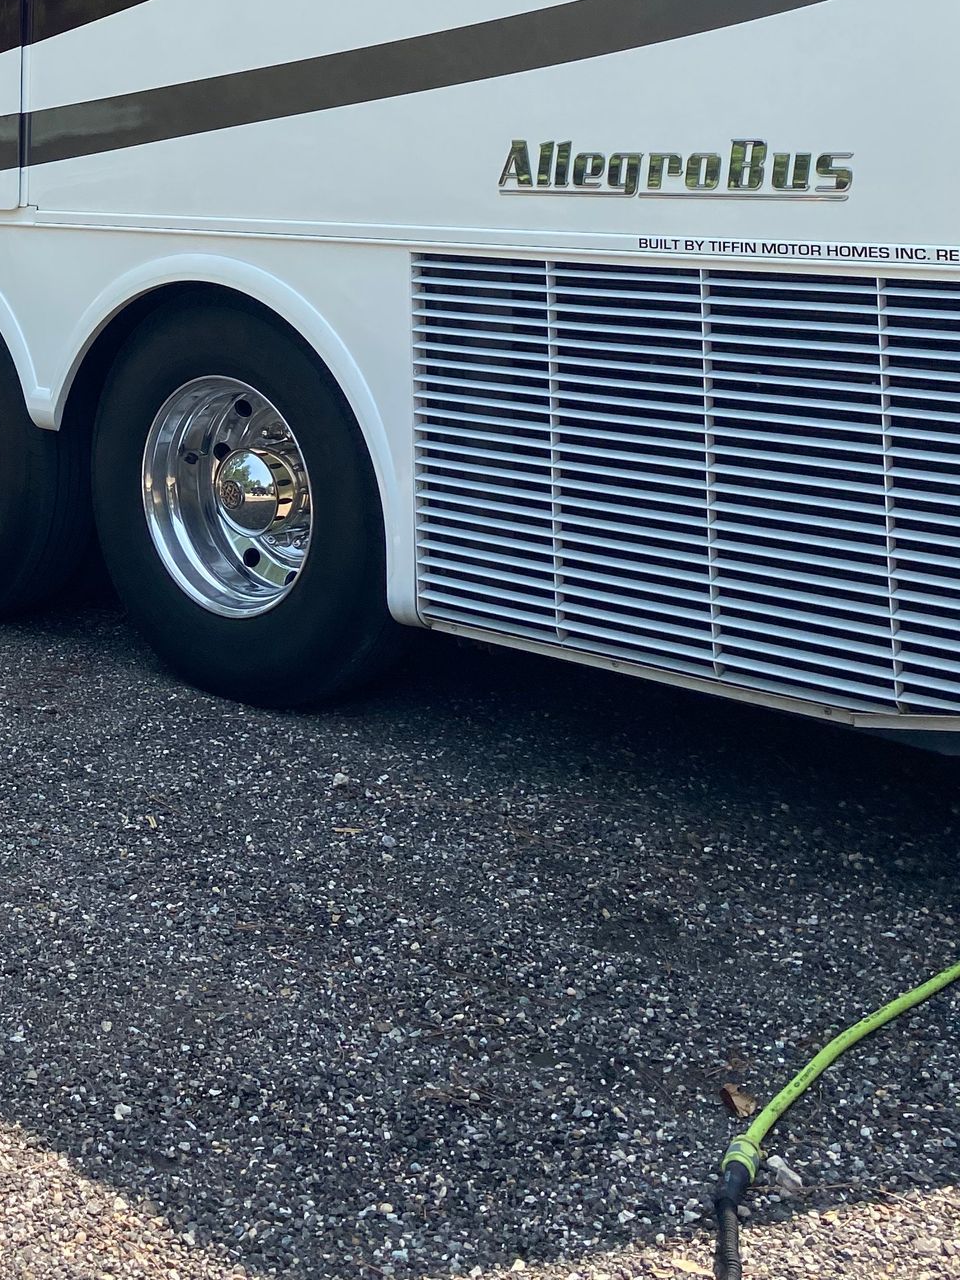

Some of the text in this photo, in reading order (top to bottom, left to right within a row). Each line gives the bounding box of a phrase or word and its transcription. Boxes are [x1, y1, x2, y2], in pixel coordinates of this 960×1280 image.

[638, 238, 680, 250] BUILT
[684, 239, 704, 251] BY
[709, 240, 756, 253] TIFFIN
[762, 243, 821, 256] MOTOR
[827, 245, 890, 259] HOMES
[896, 247, 931, 260] INC.
